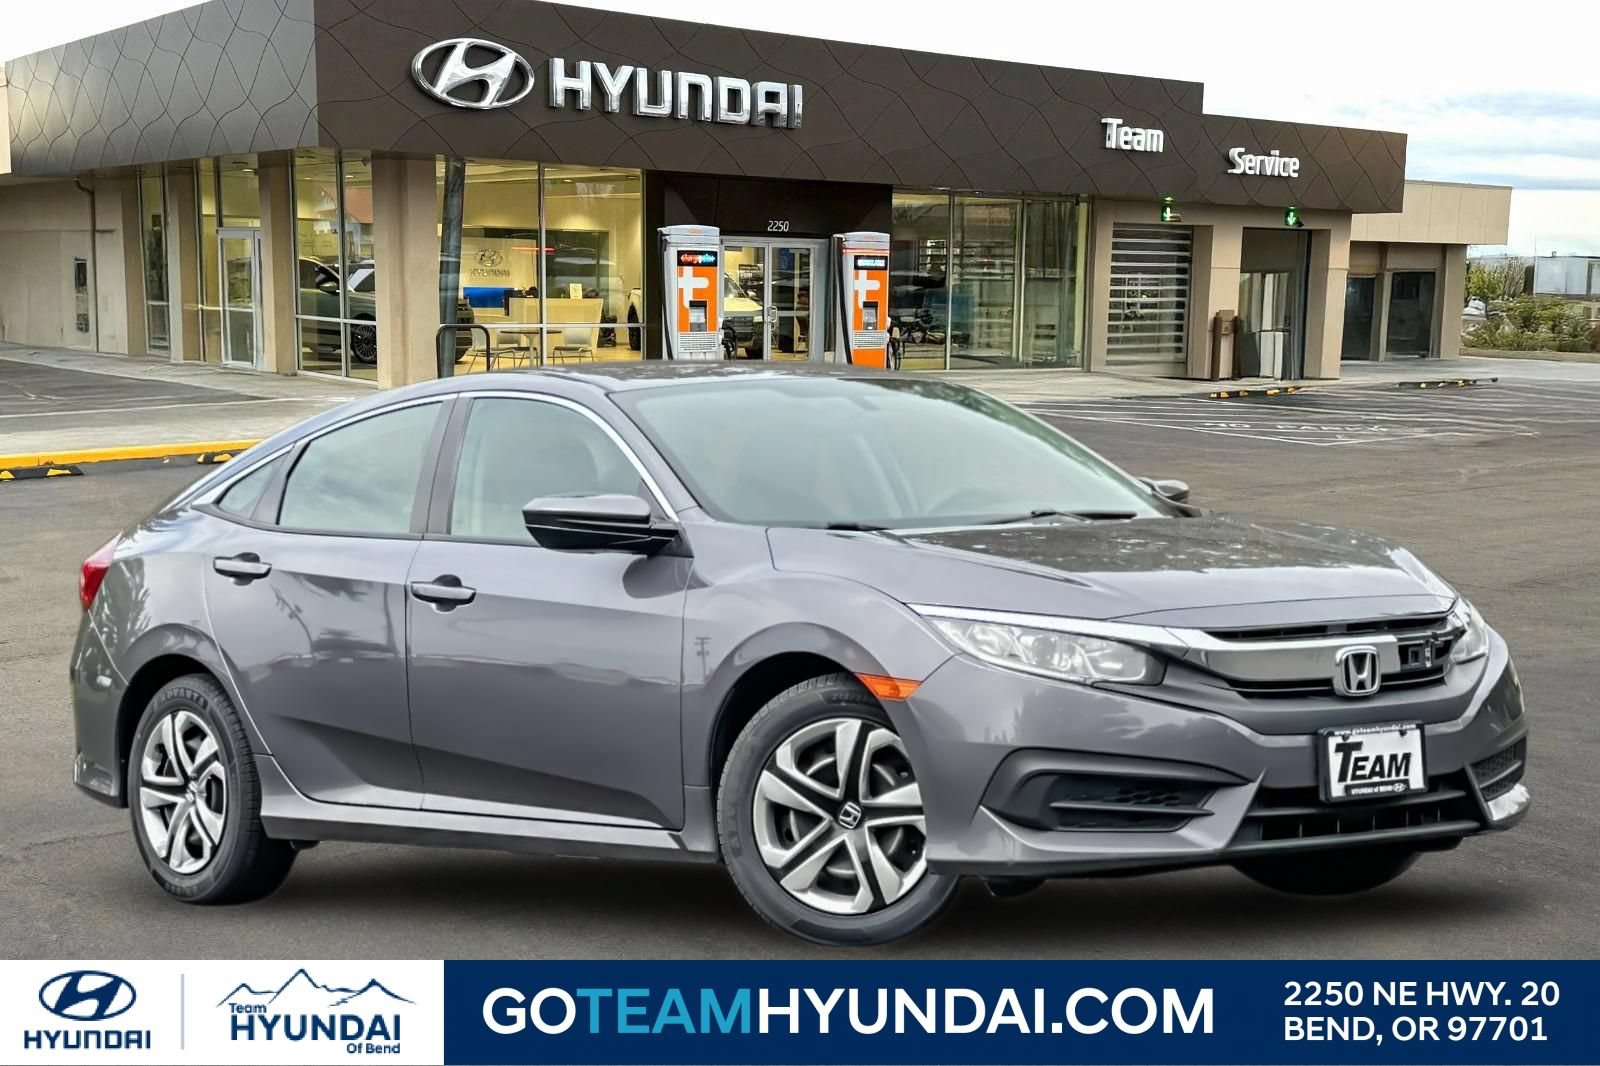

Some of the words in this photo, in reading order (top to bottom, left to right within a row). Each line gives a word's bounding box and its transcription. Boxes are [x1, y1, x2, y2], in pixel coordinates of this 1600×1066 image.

[549, 58, 804, 129] HYUNDAI
[1101, 117, 1164, 153] Team
[1227, 147, 1300, 178] Service
[767, 220, 790, 232] 2250
